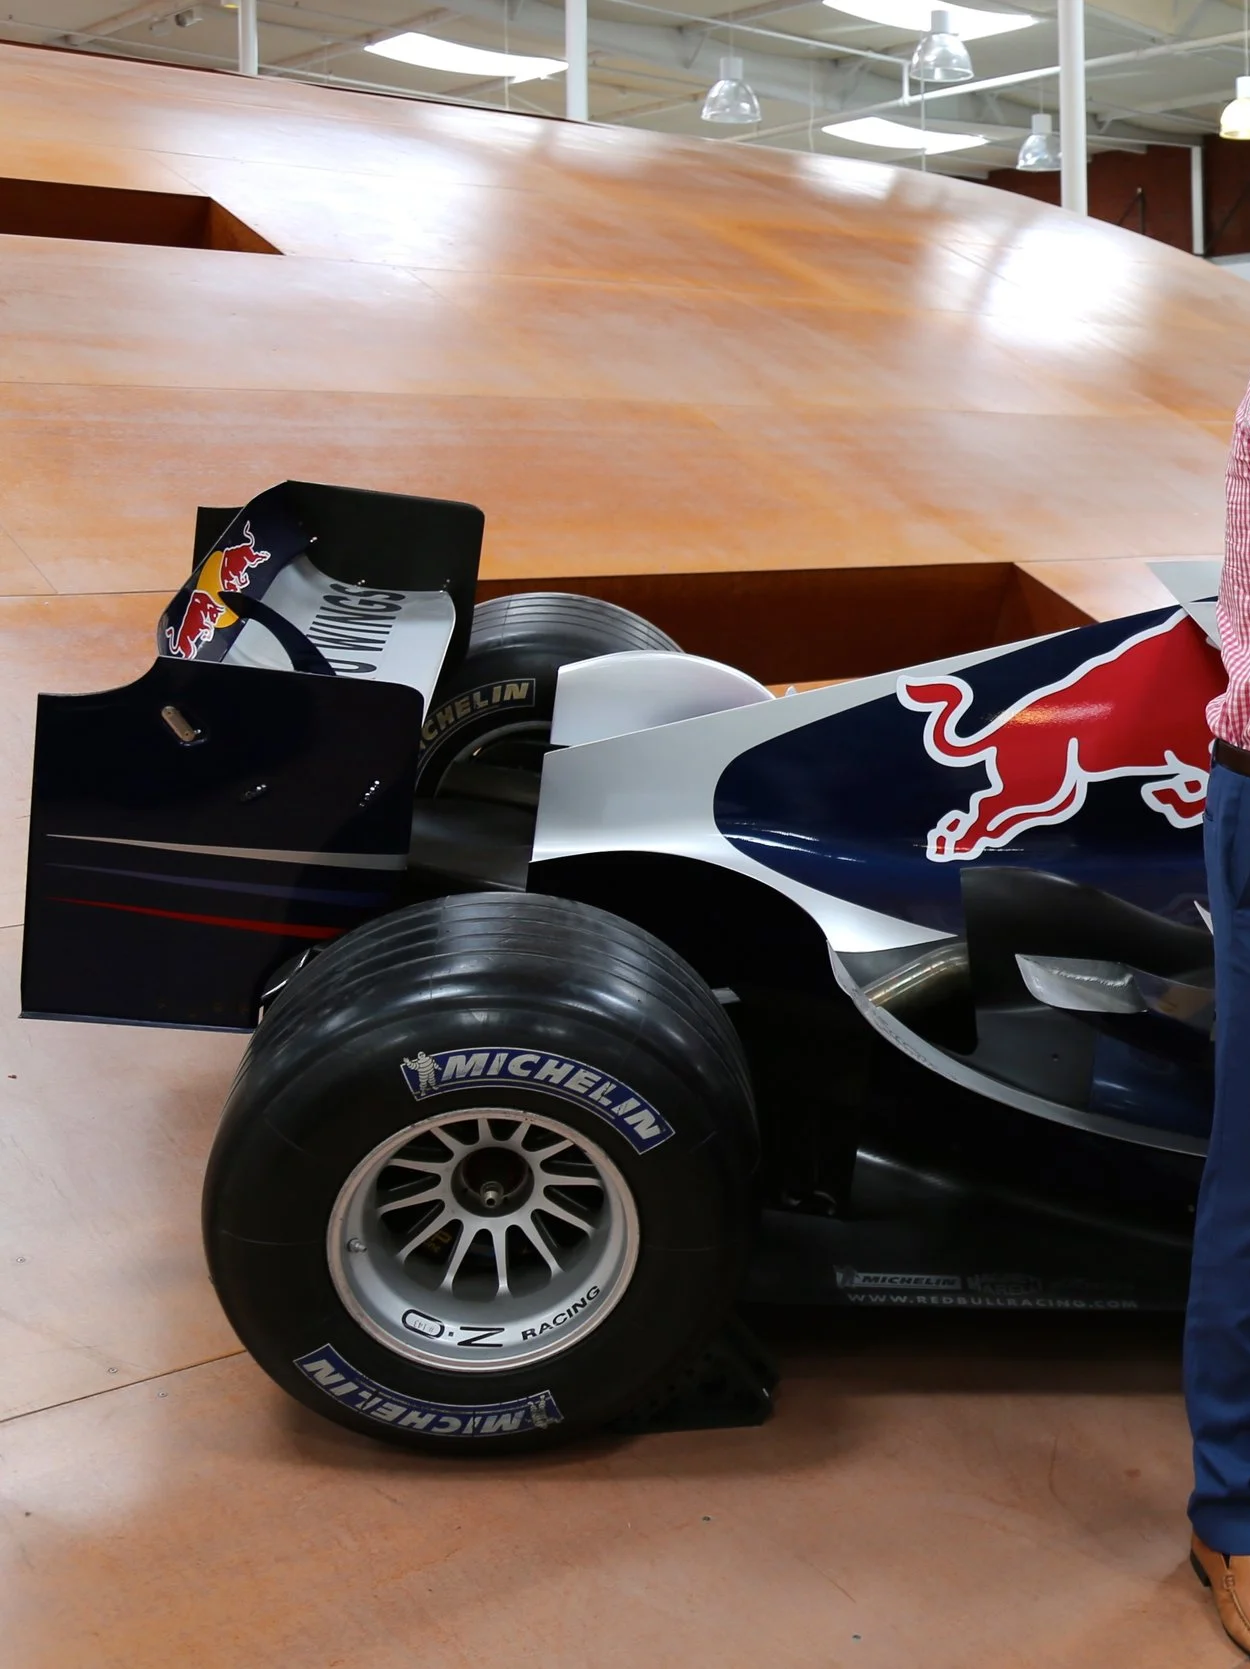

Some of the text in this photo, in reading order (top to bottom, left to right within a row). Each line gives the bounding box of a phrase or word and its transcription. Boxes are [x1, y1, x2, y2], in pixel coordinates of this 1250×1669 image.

[305, 583, 406, 652] WINGS
[420, 681, 530, 749] CHELIN
[440, 1052, 662, 1141] MICHELIN
[521, 1285, 601, 1341] RACING
[861, 1274, 957, 1287] MICHELIN
[303, 1358, 527, 1434] MICHELIN
